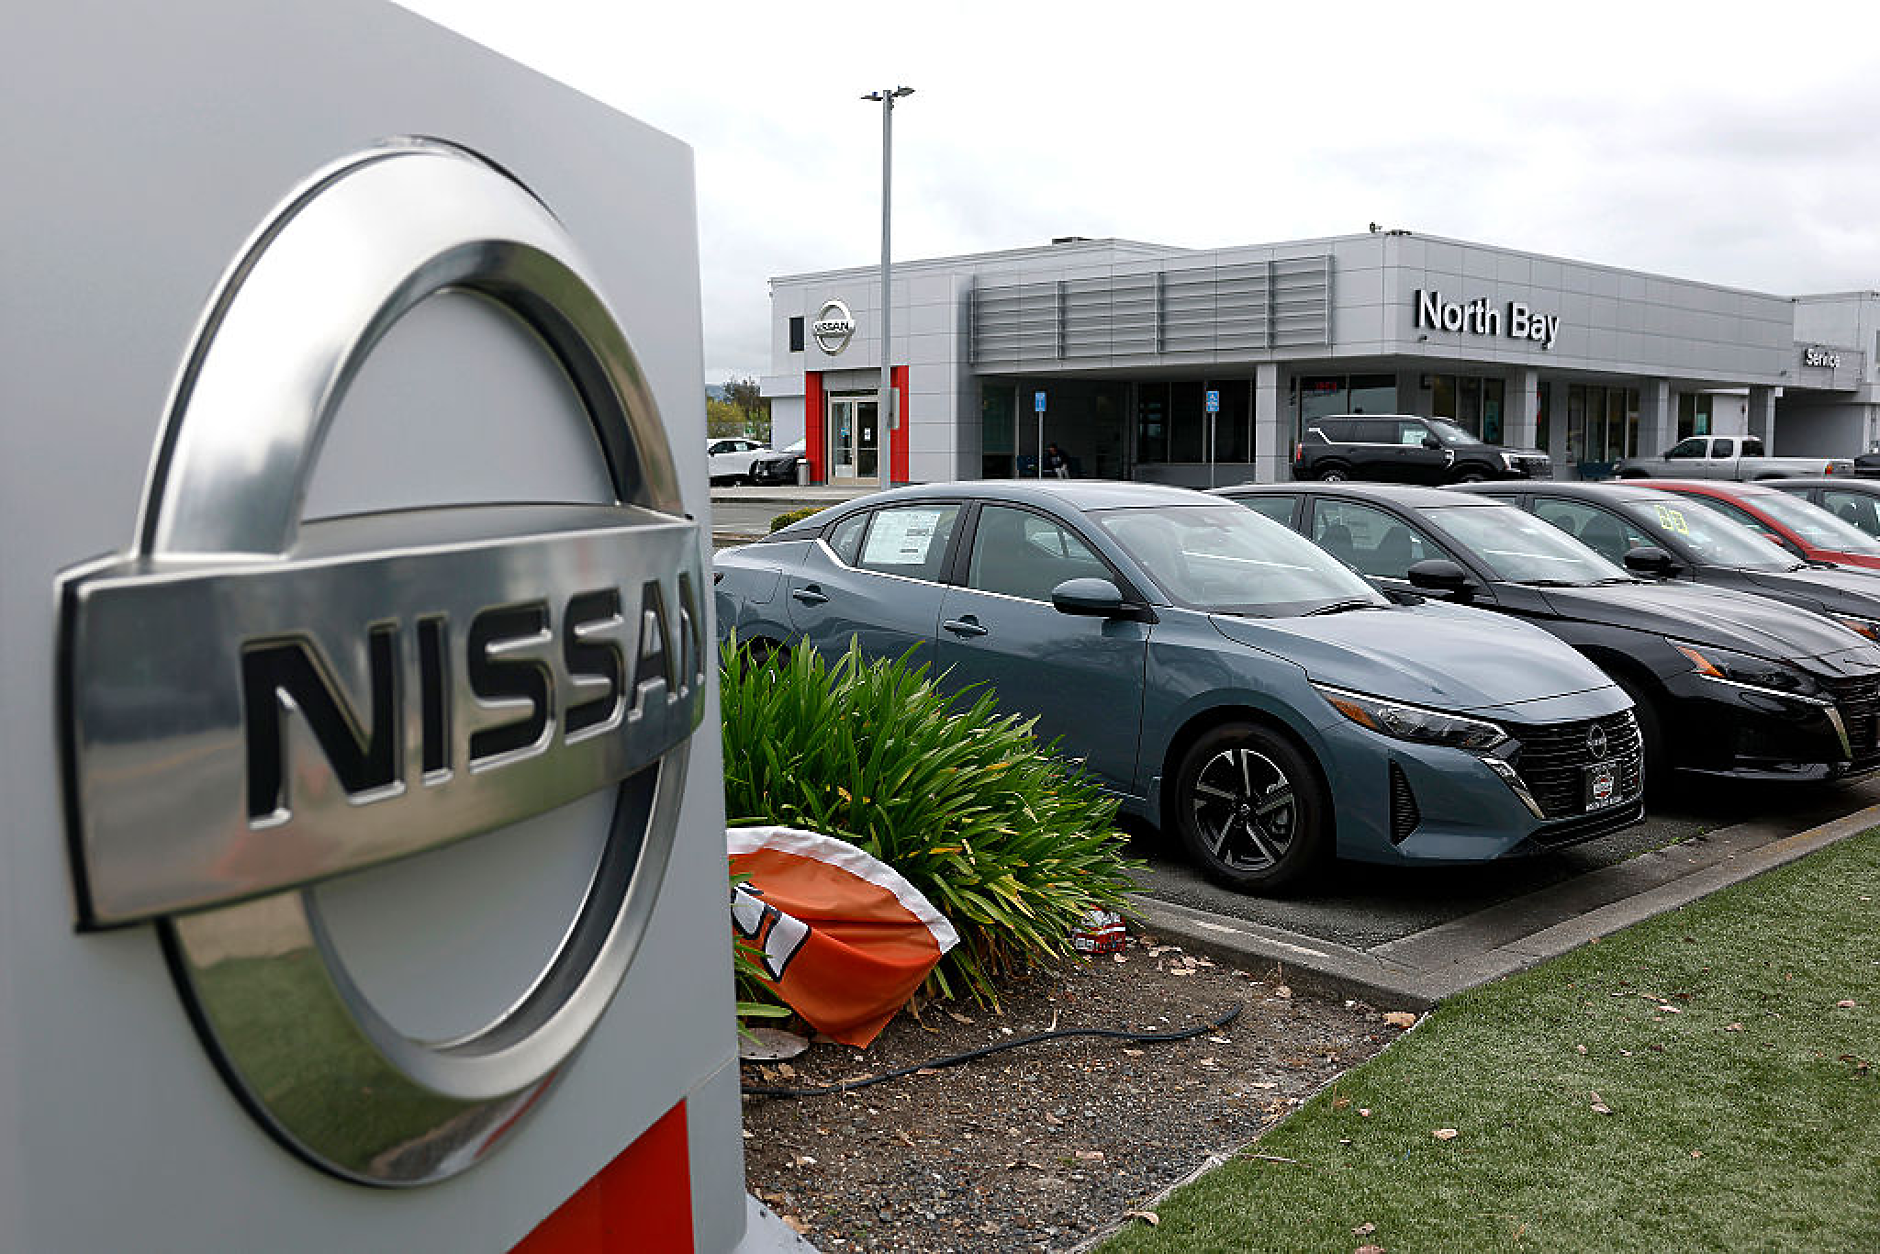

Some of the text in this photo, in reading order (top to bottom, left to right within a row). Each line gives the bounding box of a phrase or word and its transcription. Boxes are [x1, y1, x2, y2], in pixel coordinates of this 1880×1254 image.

[1414, 289, 1560, 350] North Bay
[1804, 348, 1840, 368] Service
[241, 571, 703, 830] NISSAN
